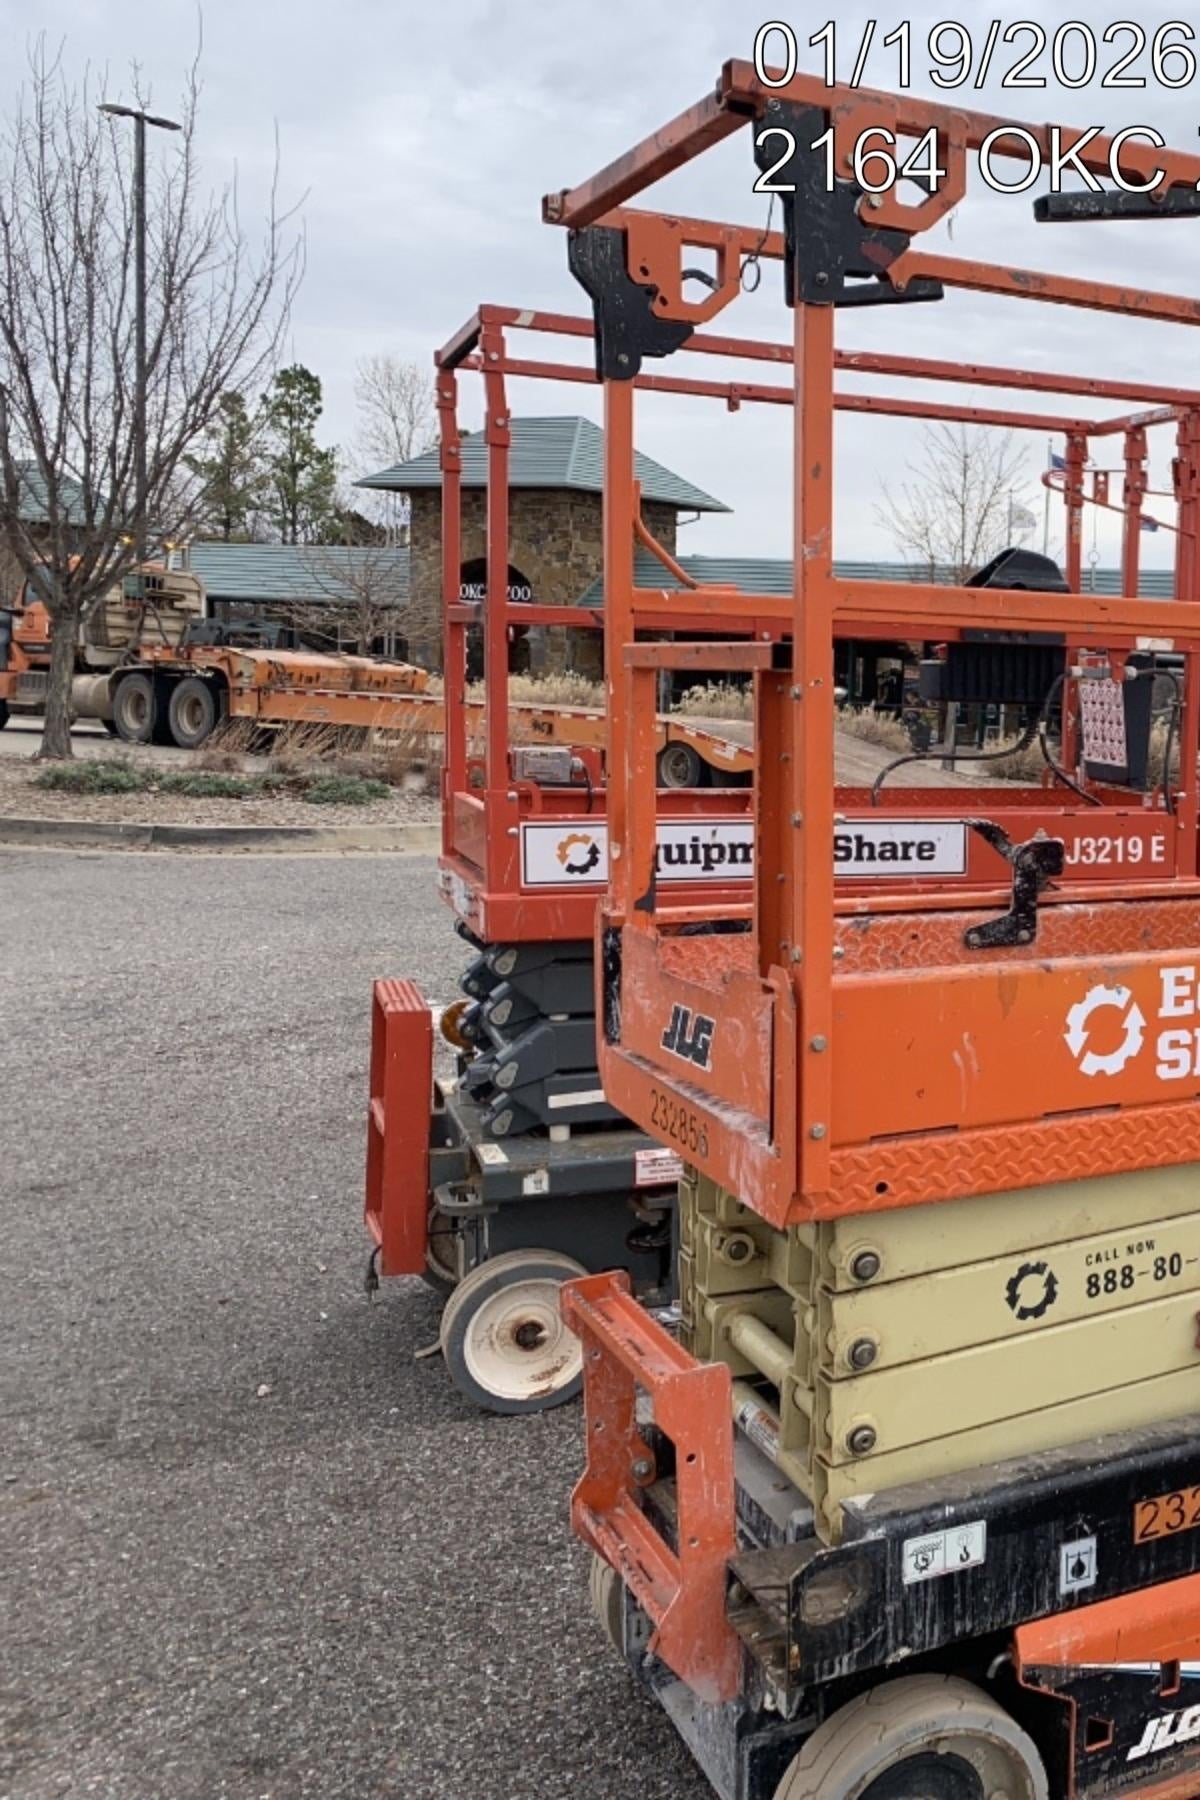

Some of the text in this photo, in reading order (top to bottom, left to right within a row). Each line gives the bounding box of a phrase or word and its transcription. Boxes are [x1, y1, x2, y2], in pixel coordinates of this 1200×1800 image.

[460, 584, 531, 601] OKC OO
[834, 835, 936, 862] Share
[1052, 835, 1165, 864] J3219 E
[661, 1003, 715, 1071] JLG
[651, 1090, 708, 1157] 232856
[1085, 1240, 1156, 1267] CALL NOW
